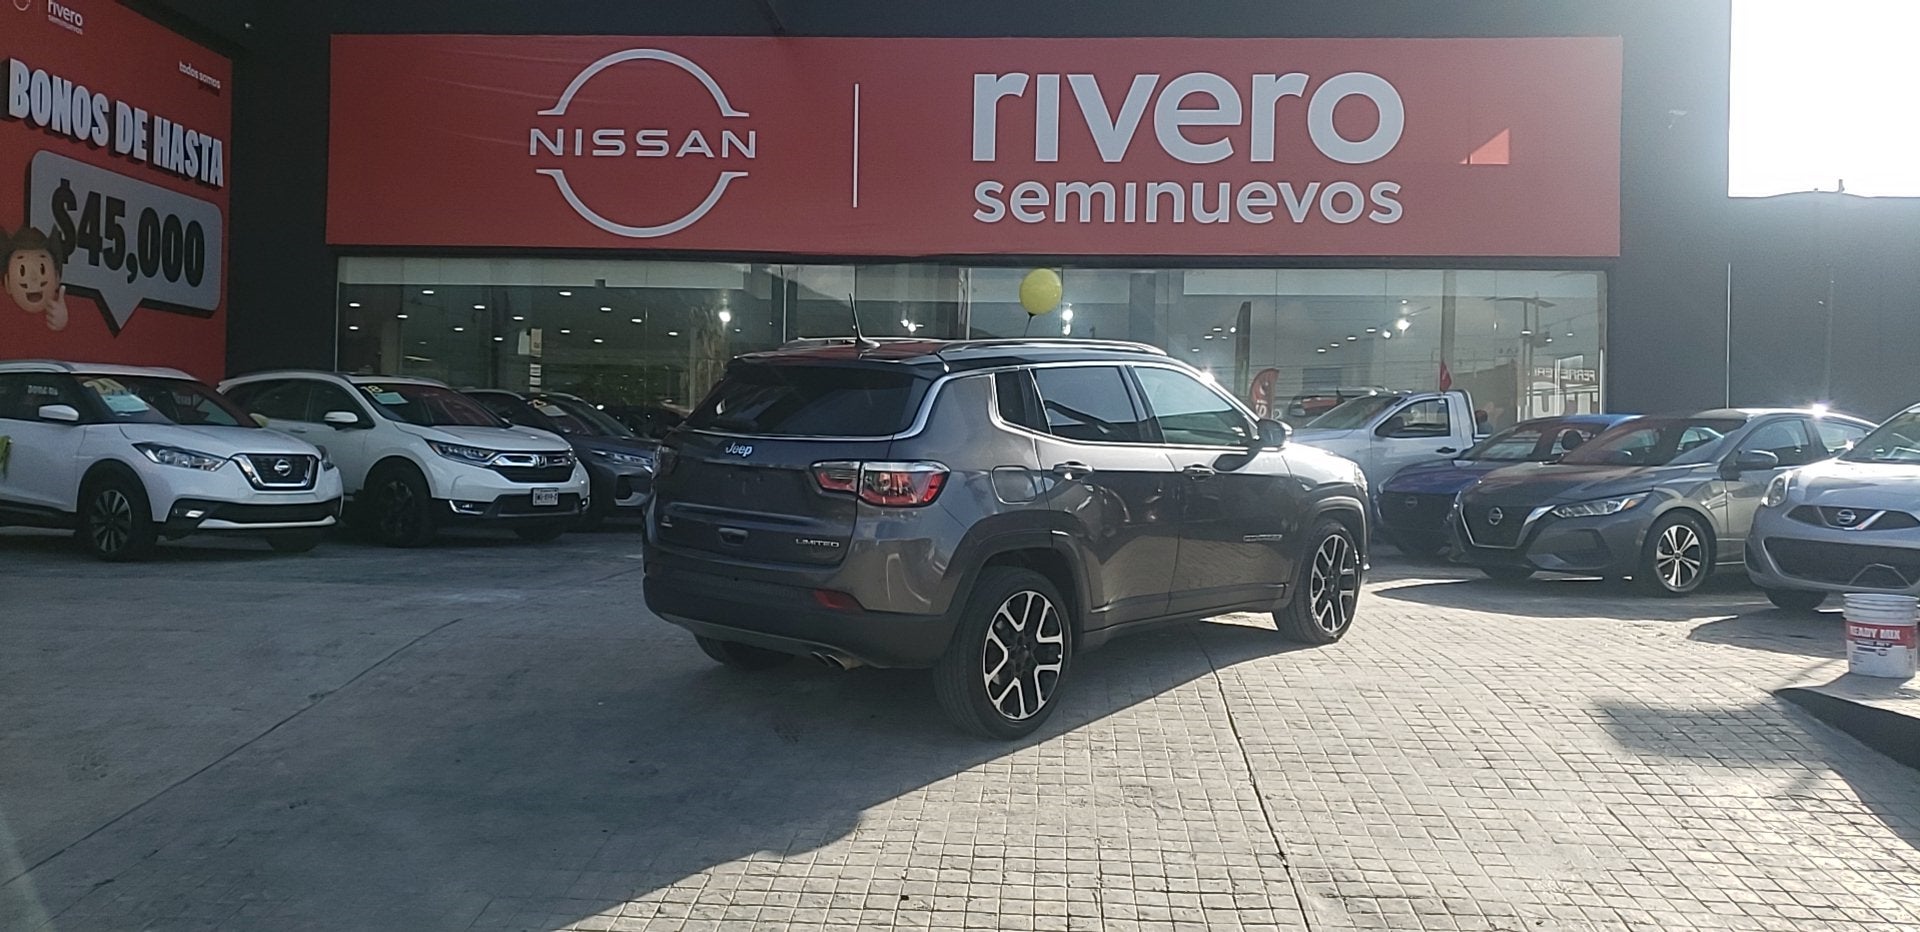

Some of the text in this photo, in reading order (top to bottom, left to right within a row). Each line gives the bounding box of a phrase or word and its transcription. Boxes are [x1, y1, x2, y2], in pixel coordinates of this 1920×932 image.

[48, 0, 83, 26] rivero
[179, 60, 199, 79] todos
[9, 58, 224, 187] BONOS DE HASTA
[972, 72, 1405, 163] rivero
[529, 128, 756, 158] NISSAN
[973, 180, 1403, 223] seminuevos
[52, 178, 205, 288] $45,000
[725, 441, 753, 457] Jeep
[795, 538, 840, 548] LIMITED
